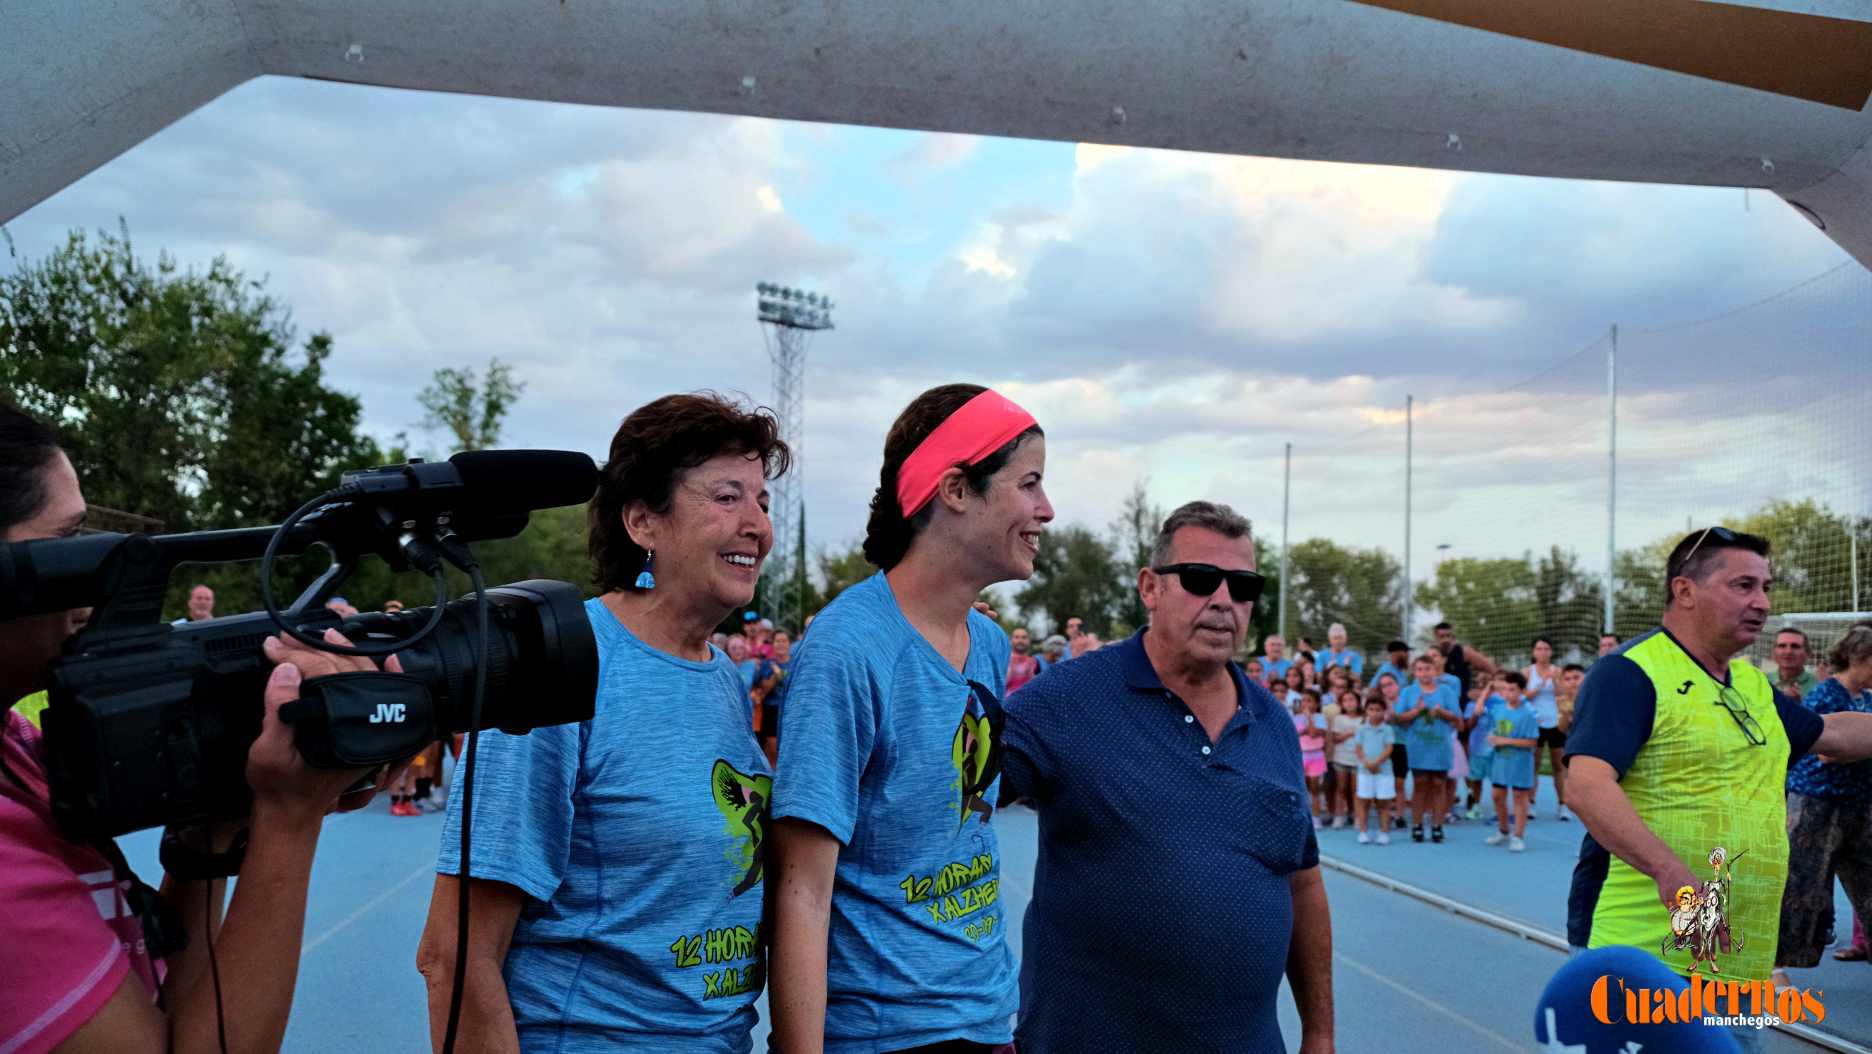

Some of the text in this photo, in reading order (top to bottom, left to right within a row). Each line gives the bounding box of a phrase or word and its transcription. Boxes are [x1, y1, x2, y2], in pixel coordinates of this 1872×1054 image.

[369, 703, 406, 723] JVC
[900, 874, 933, 904] 12
[671, 935, 702, 968] 12
